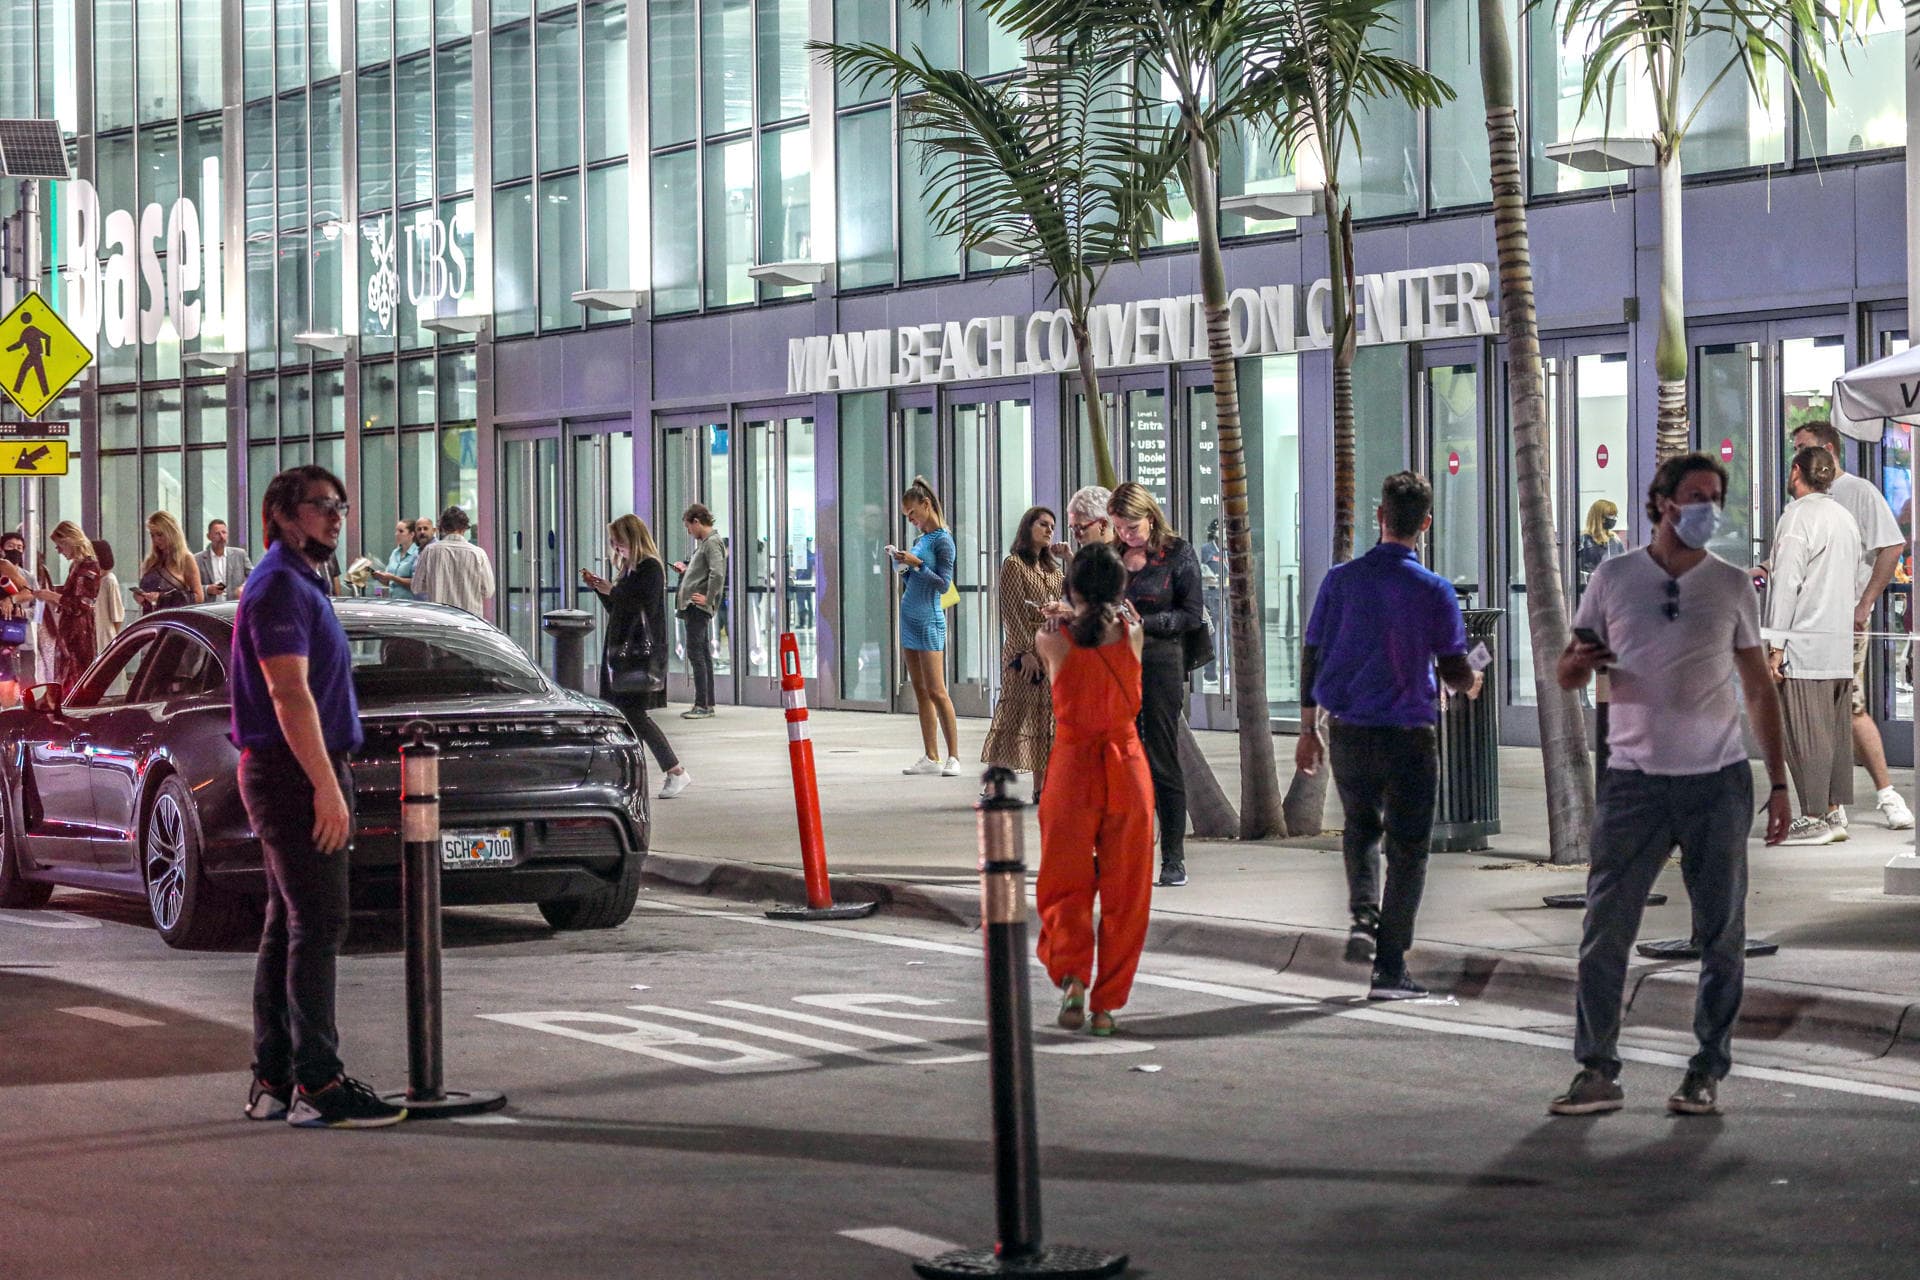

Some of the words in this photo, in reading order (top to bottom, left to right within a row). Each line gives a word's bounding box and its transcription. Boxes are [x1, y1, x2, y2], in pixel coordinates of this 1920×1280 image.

[67, 156, 222, 348] Basel
[404, 214, 467, 306] UBS
[789, 329, 892, 394] MIAMI
[899, 315, 1016, 384] BEACH
[1025, 284, 1295, 373] CONVENTON
[445, 840, 471, 859] SCH
[486, 839, 510, 857] 700
[475, 993, 1156, 1075] BUS
